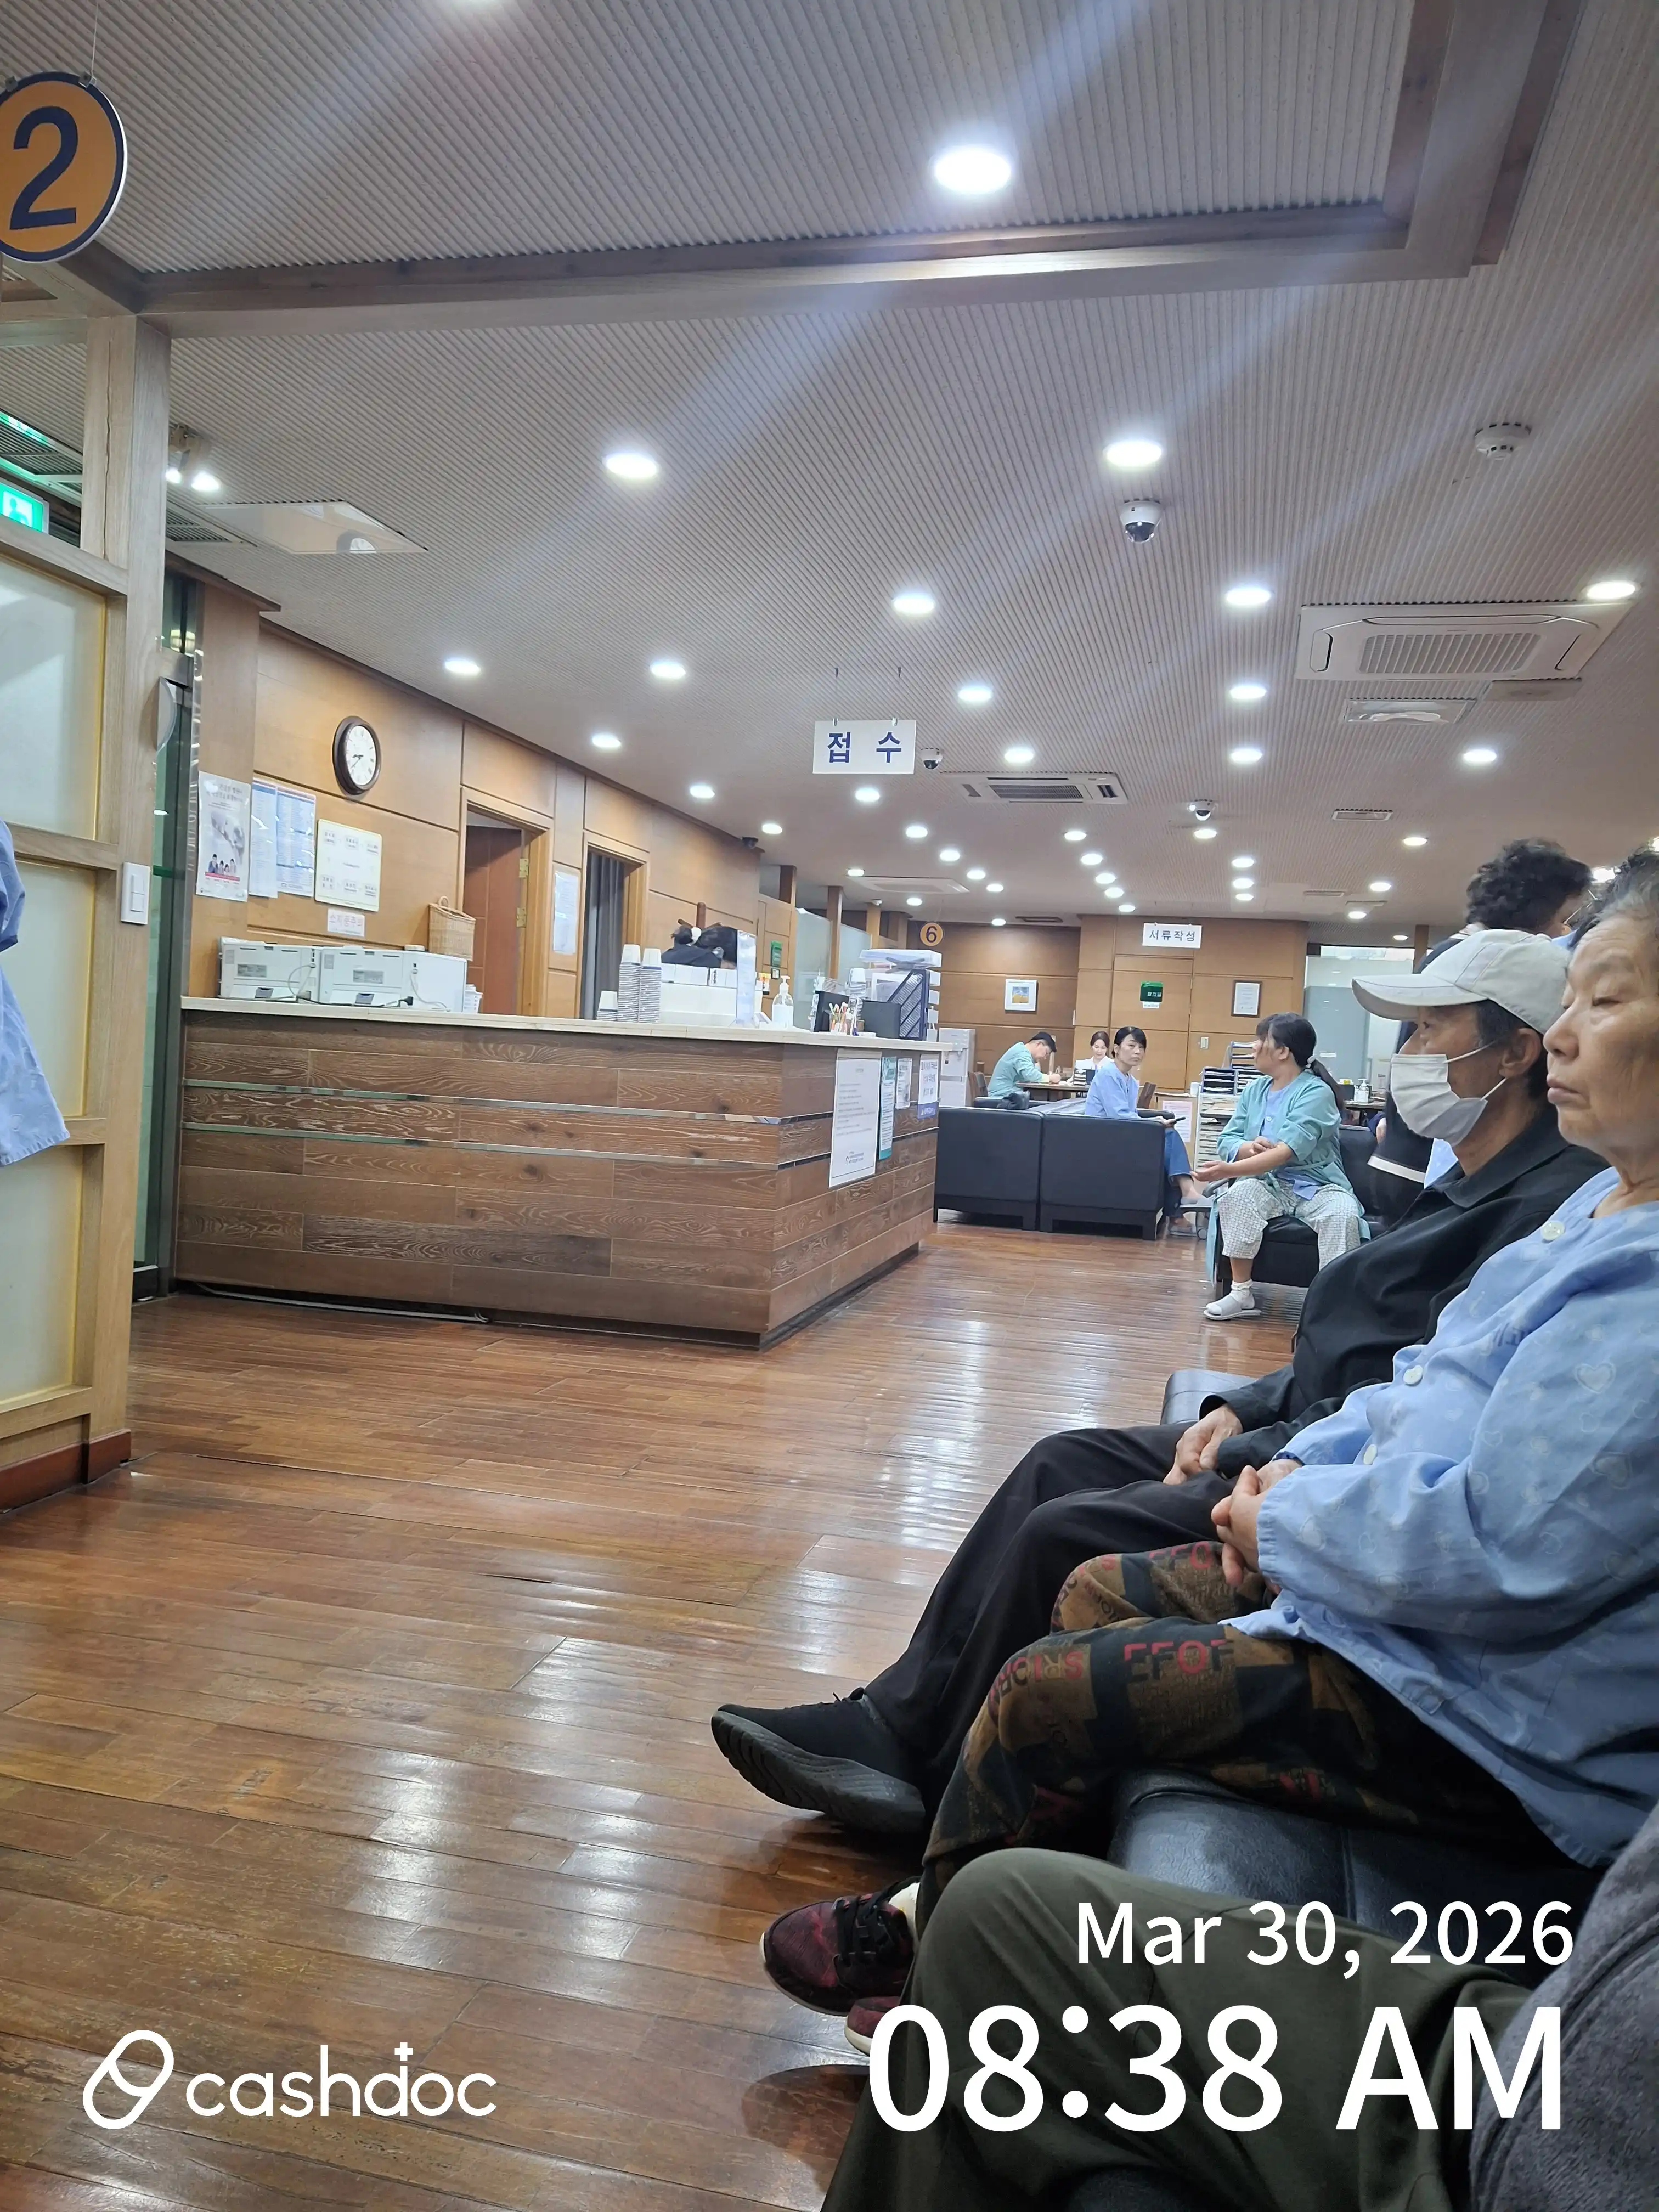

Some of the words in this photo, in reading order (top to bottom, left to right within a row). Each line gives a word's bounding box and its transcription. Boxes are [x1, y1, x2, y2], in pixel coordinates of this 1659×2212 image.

[9, 106, 78, 230] 2
[926, 925, 938, 943] 6
[1149, 930, 1195, 941] 서류작성
